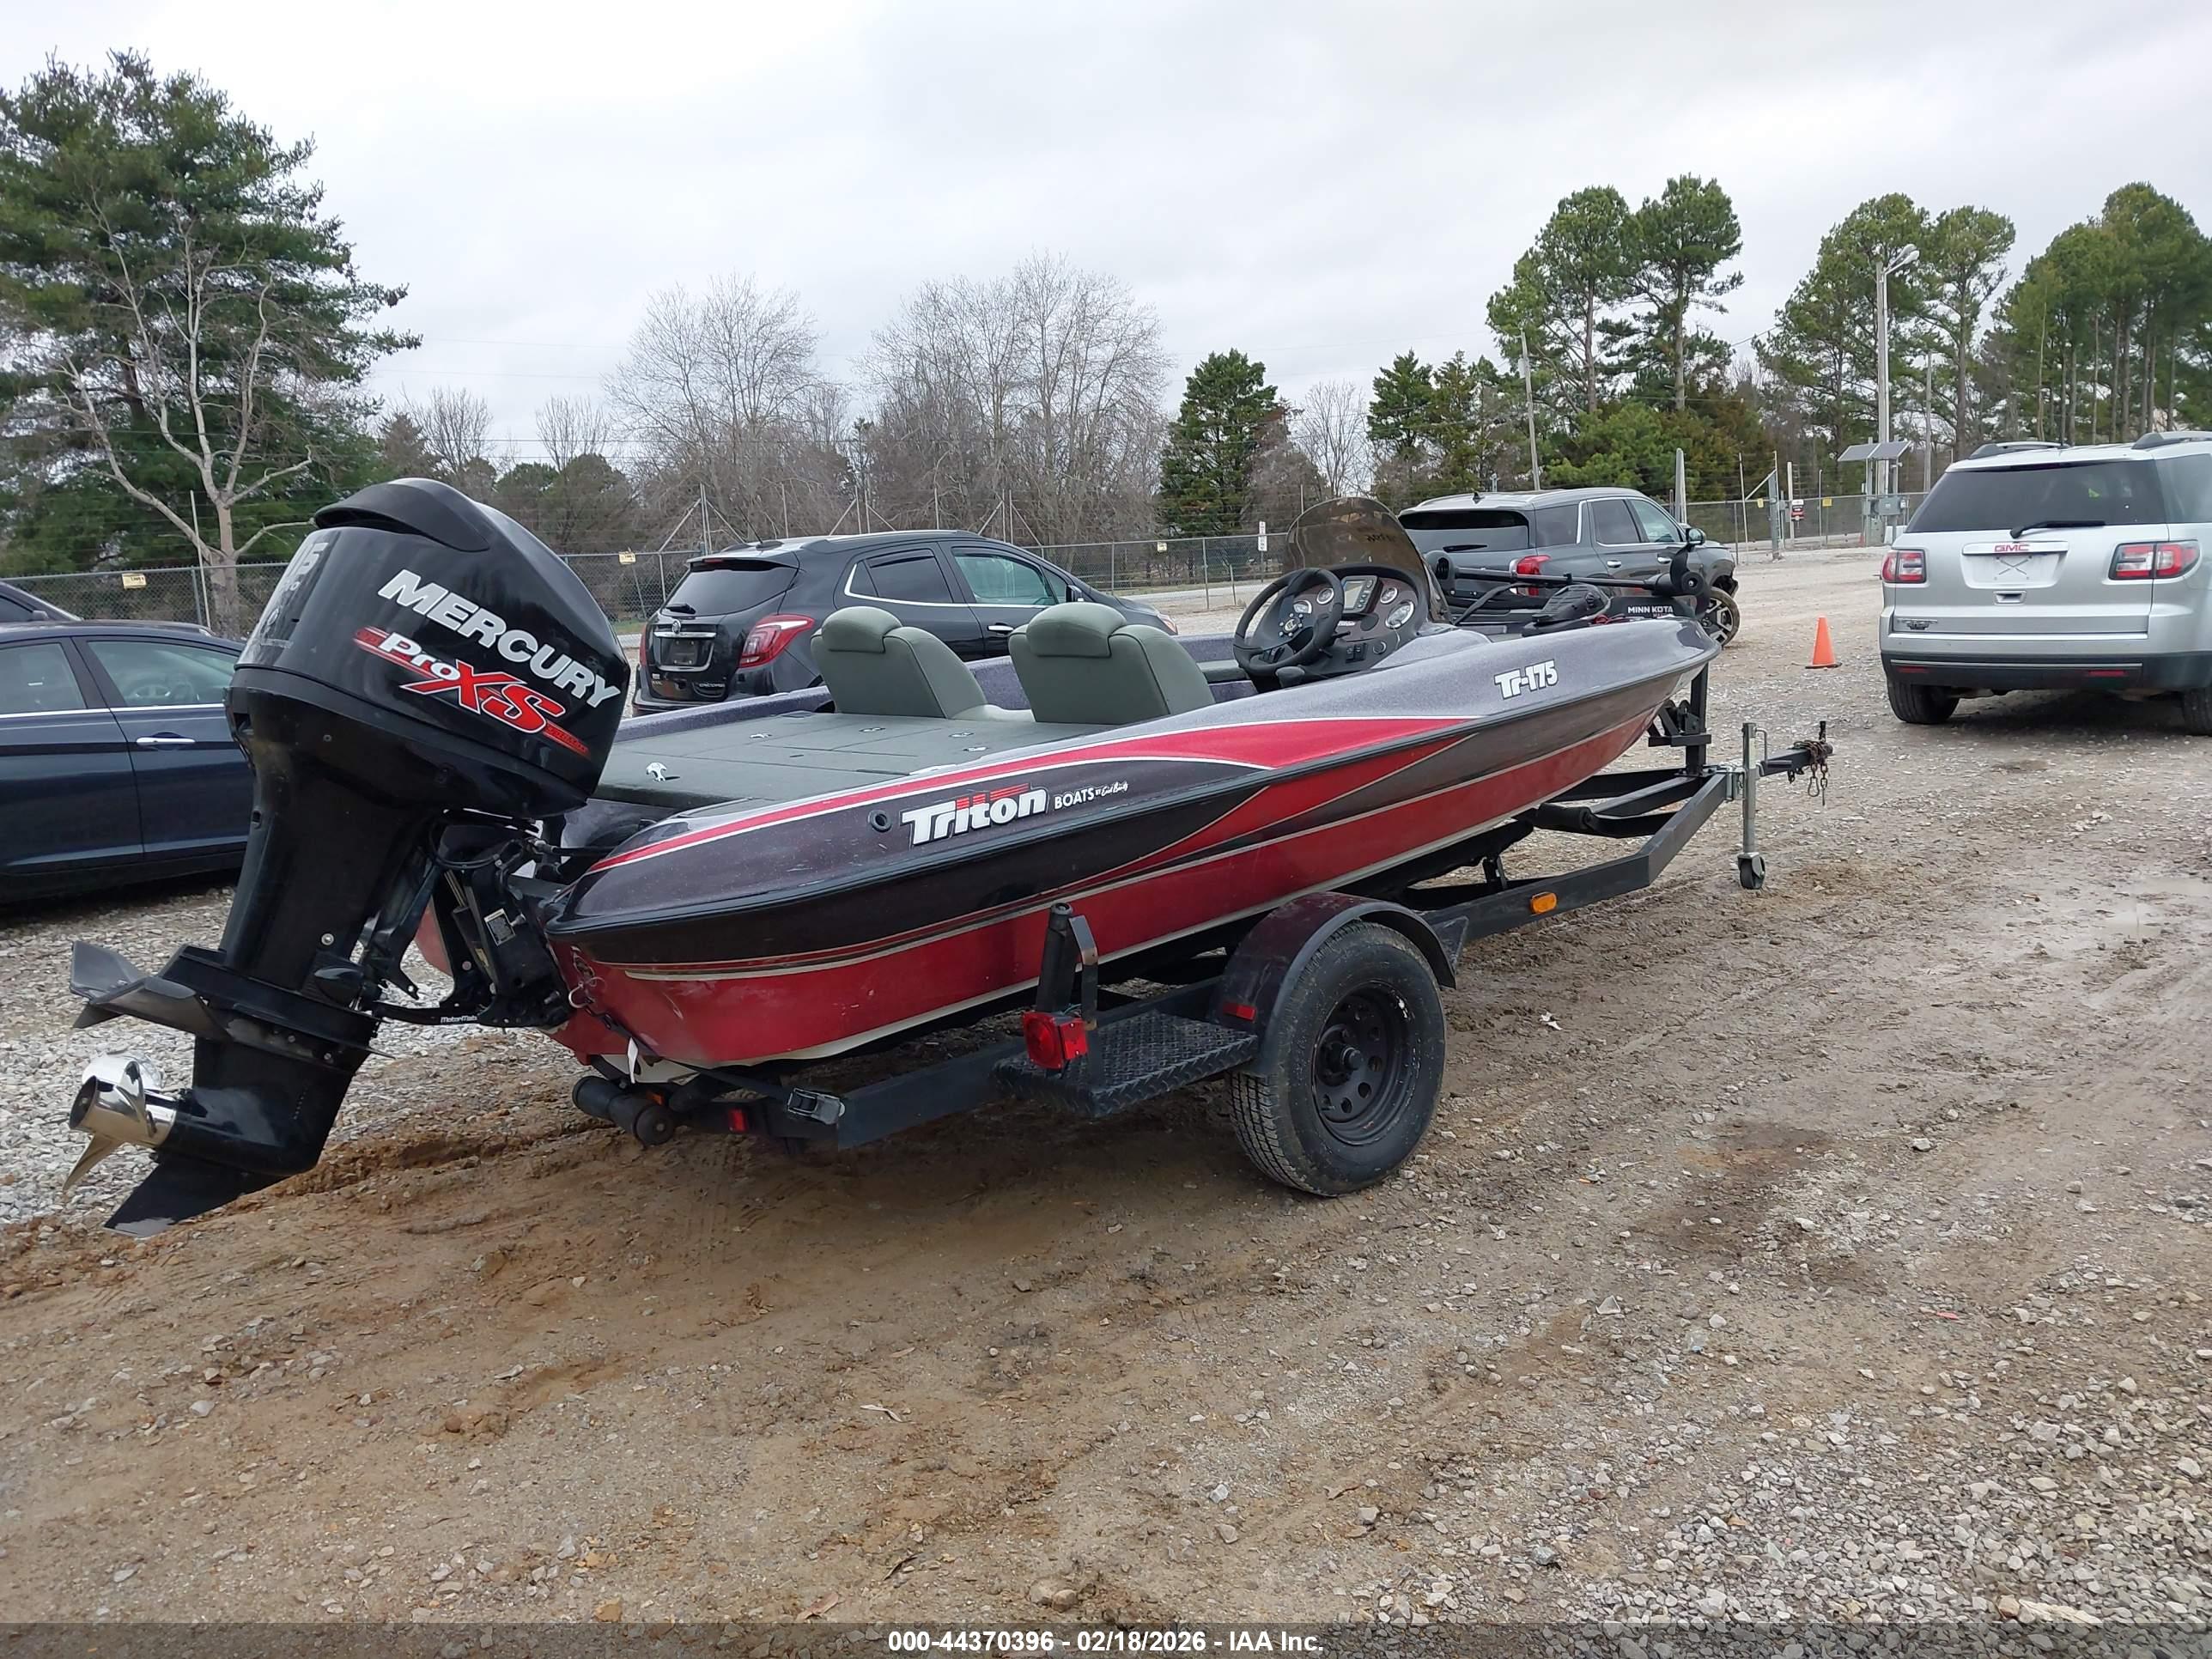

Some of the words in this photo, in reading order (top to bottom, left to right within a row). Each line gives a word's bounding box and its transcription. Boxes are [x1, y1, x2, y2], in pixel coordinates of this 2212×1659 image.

[1995, 544, 2031, 552] GMC
[378, 569, 621, 708] MERCURY
[1494, 659, 1559, 700] Tr-175
[901, 783, 1048, 846] Triton
[1054, 787, 1095, 810] BOATS
